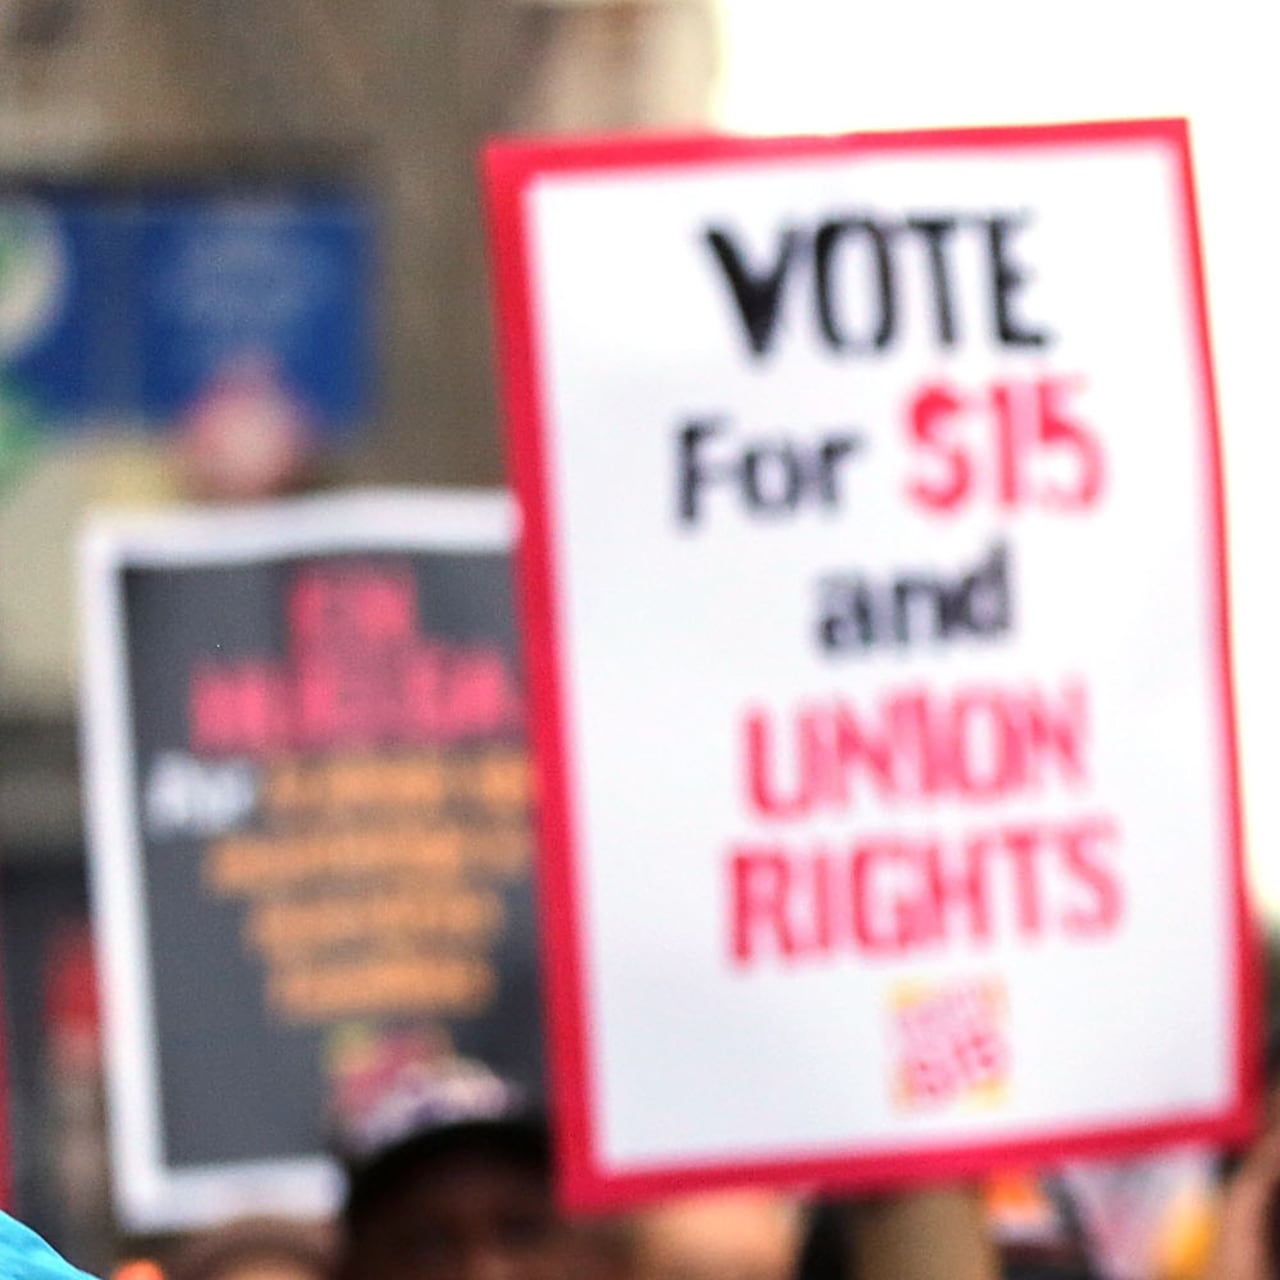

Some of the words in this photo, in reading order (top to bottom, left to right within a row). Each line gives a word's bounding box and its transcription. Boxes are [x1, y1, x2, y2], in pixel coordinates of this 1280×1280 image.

[700, 212, 1052, 362] VOTE
[674, 410, 862, 528] For
[813, 535, 1015, 655] and
[738, 675, 1094, 824] UNION
[723, 812, 1125, 970] RIGHTS
